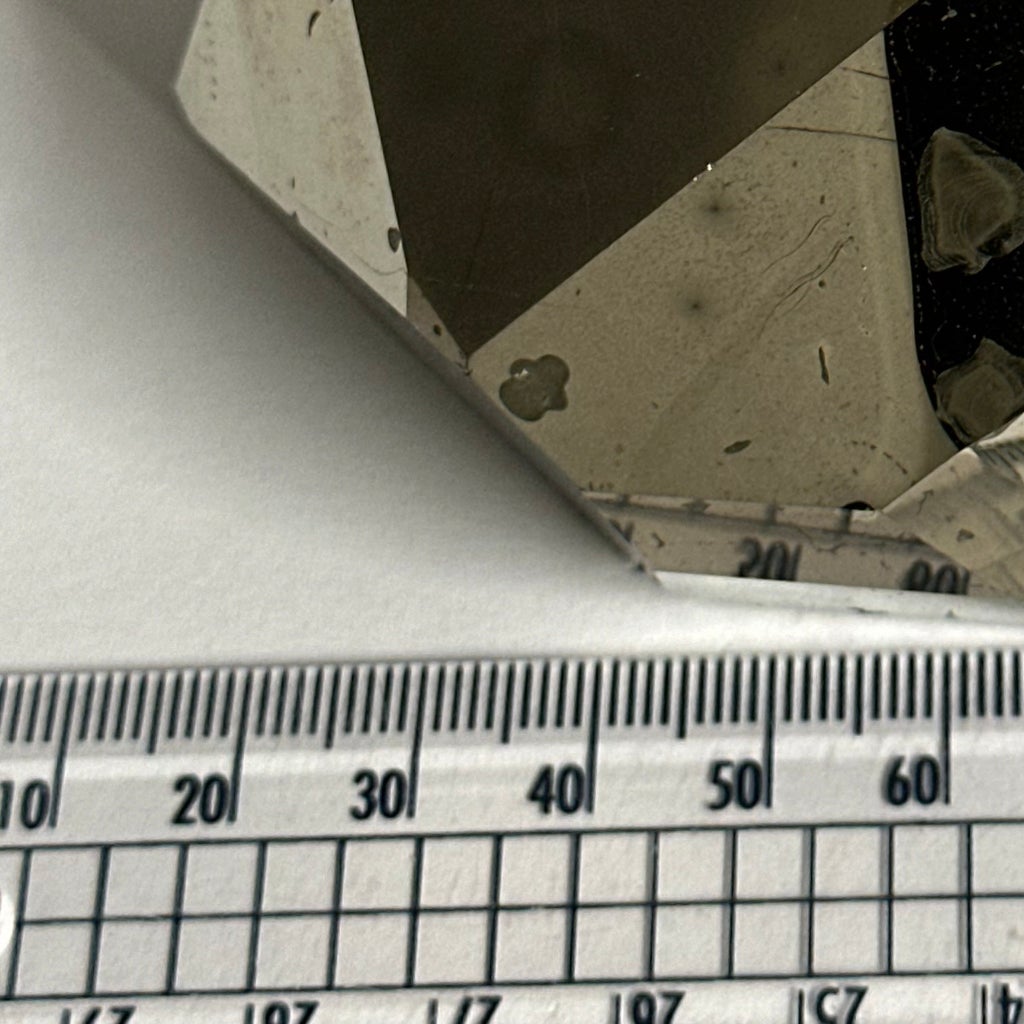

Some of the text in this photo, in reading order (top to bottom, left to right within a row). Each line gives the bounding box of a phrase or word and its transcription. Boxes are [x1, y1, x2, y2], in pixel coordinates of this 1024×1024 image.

[171, 774, 229, 826] 20
[350, 769, 405, 821] 30
[527, 764, 582, 815] 40
[705, 759, 762, 810] 50
[882, 755, 941, 807] 60
